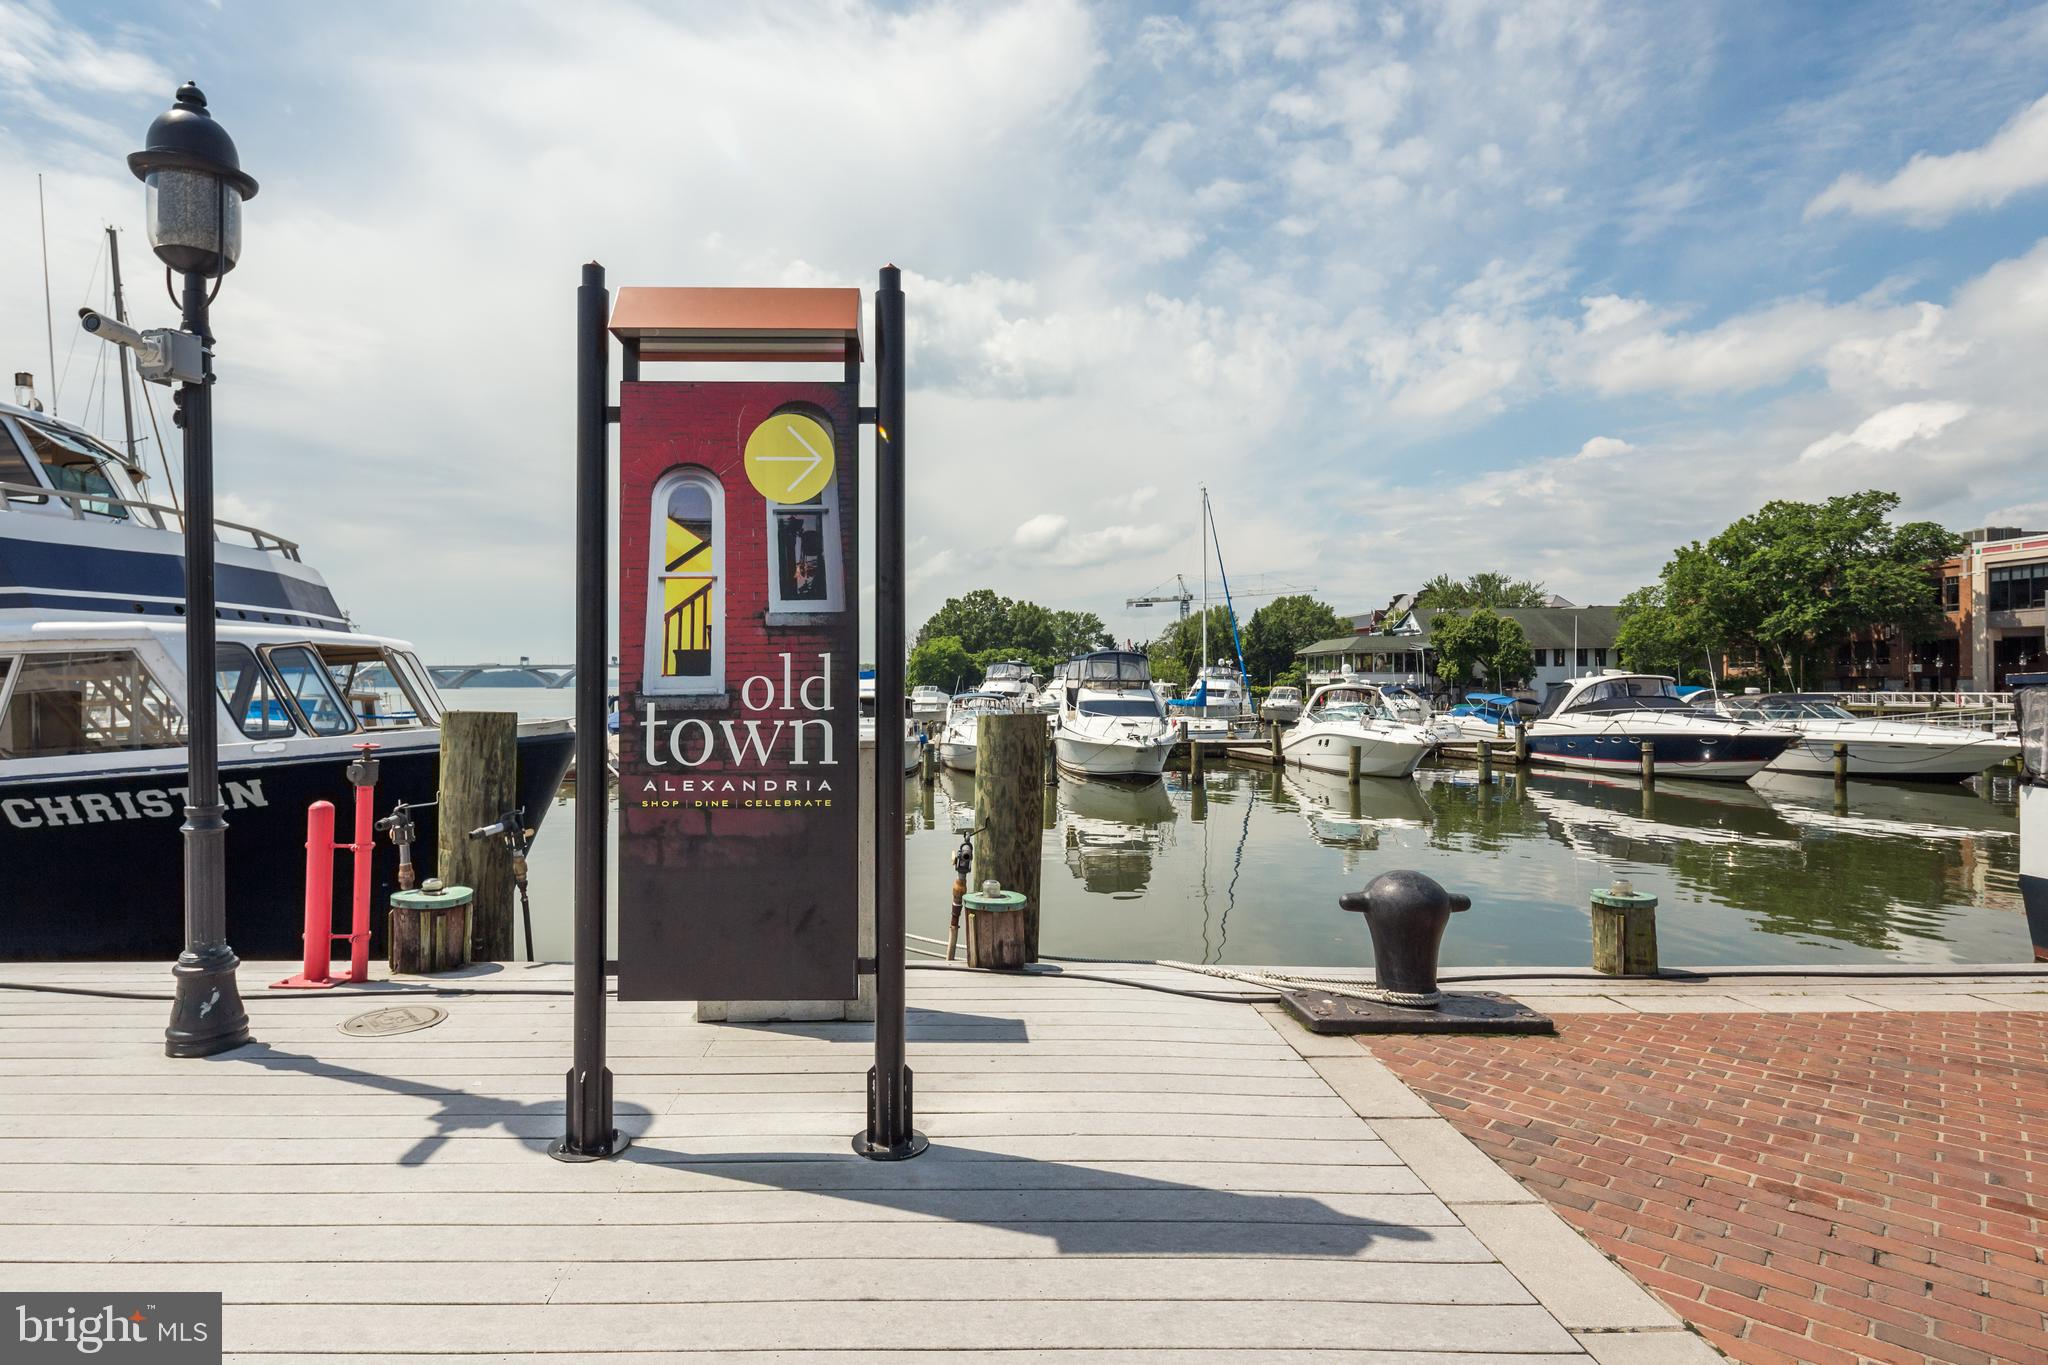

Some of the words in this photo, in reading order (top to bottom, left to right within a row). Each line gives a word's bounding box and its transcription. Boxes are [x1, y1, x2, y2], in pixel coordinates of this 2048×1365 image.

[741, 652, 835, 711] old
[640, 702, 838, 767] town
[641, 799, 679, 807] SHOP
[695, 799, 729, 807] DINE
[744, 799, 832, 807] CELEBRATE
[643, 780, 832, 791] ALEXANDRIA
